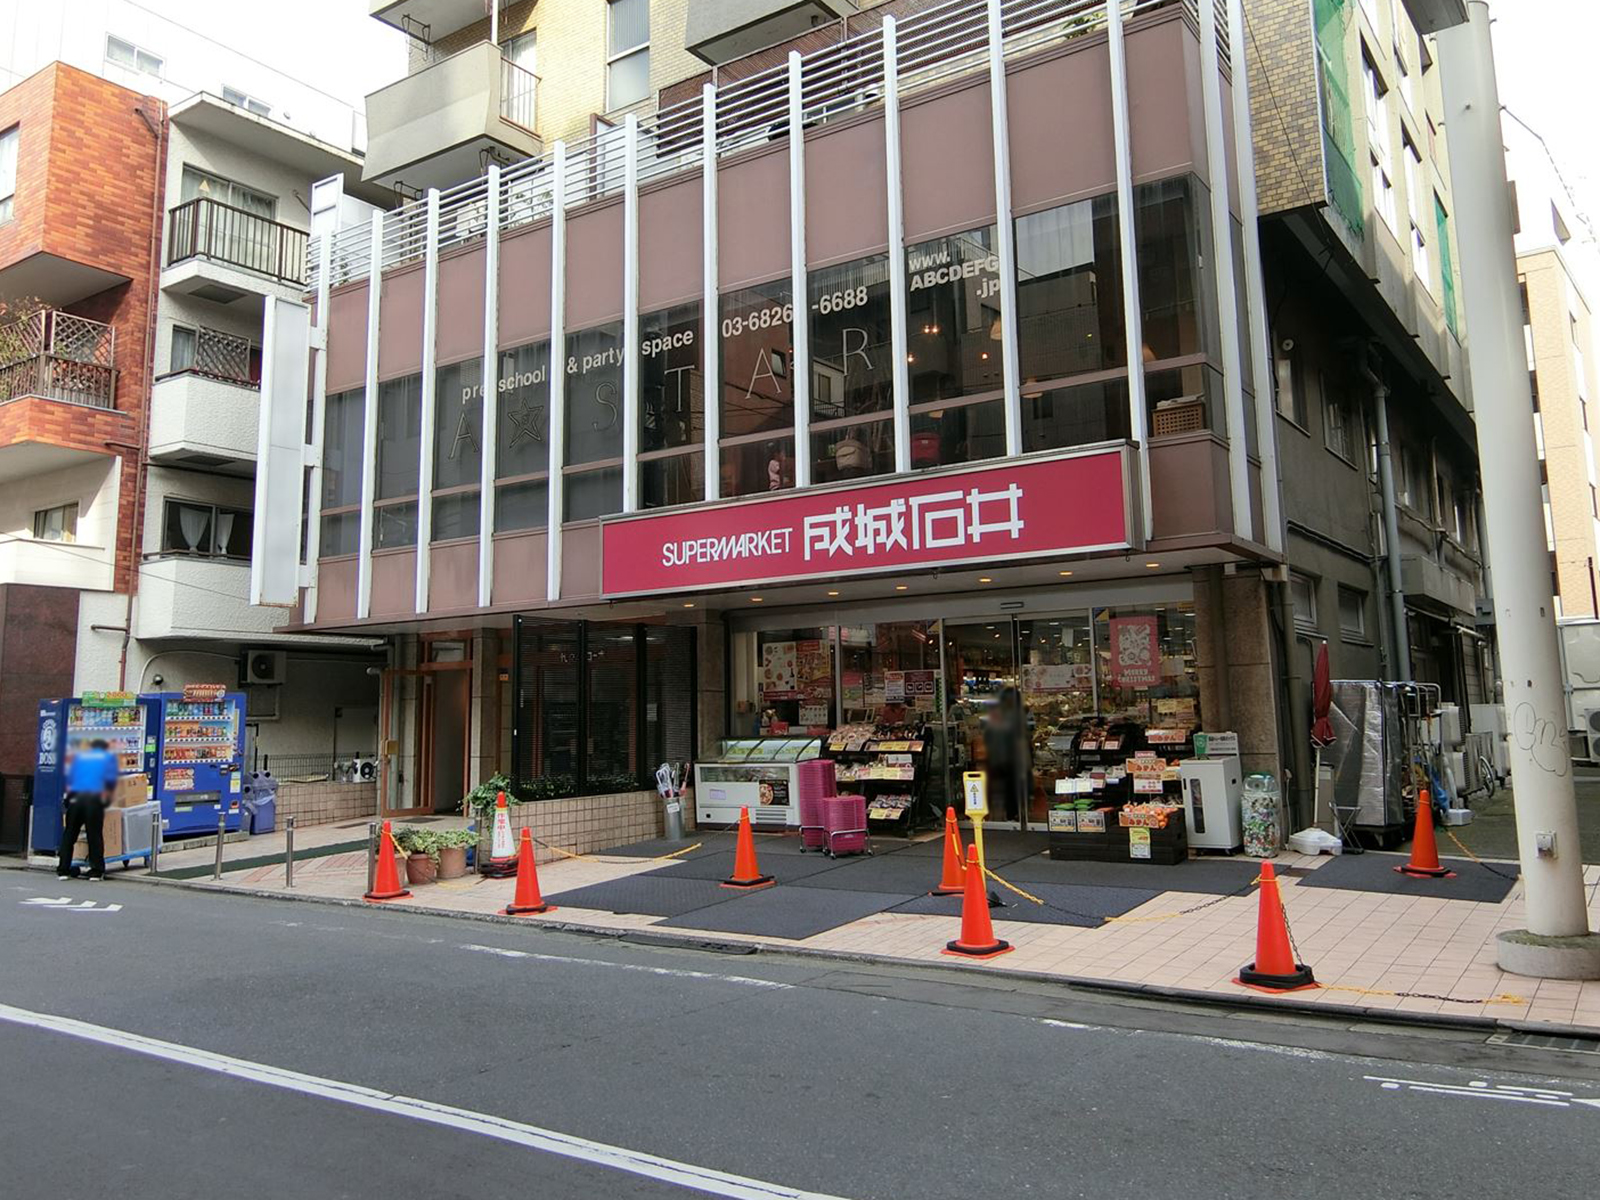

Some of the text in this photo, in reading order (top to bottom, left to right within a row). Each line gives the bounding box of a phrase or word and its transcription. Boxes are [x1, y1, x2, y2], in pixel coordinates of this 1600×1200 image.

[908, 250, 950, 273] www.
[909, 255, 999, 292] ABCDEFG
[975, 276, 1001, 299] .jp
[722, 285, 868, 338] 03-6826 -6688
[498, 365, 546, 393] school
[566, 356, 578, 374] &
[583, 347, 625, 374] party
[641, 329, 694, 358] space
[661, 483, 1025, 567] SUPERMARKET 成城石井
